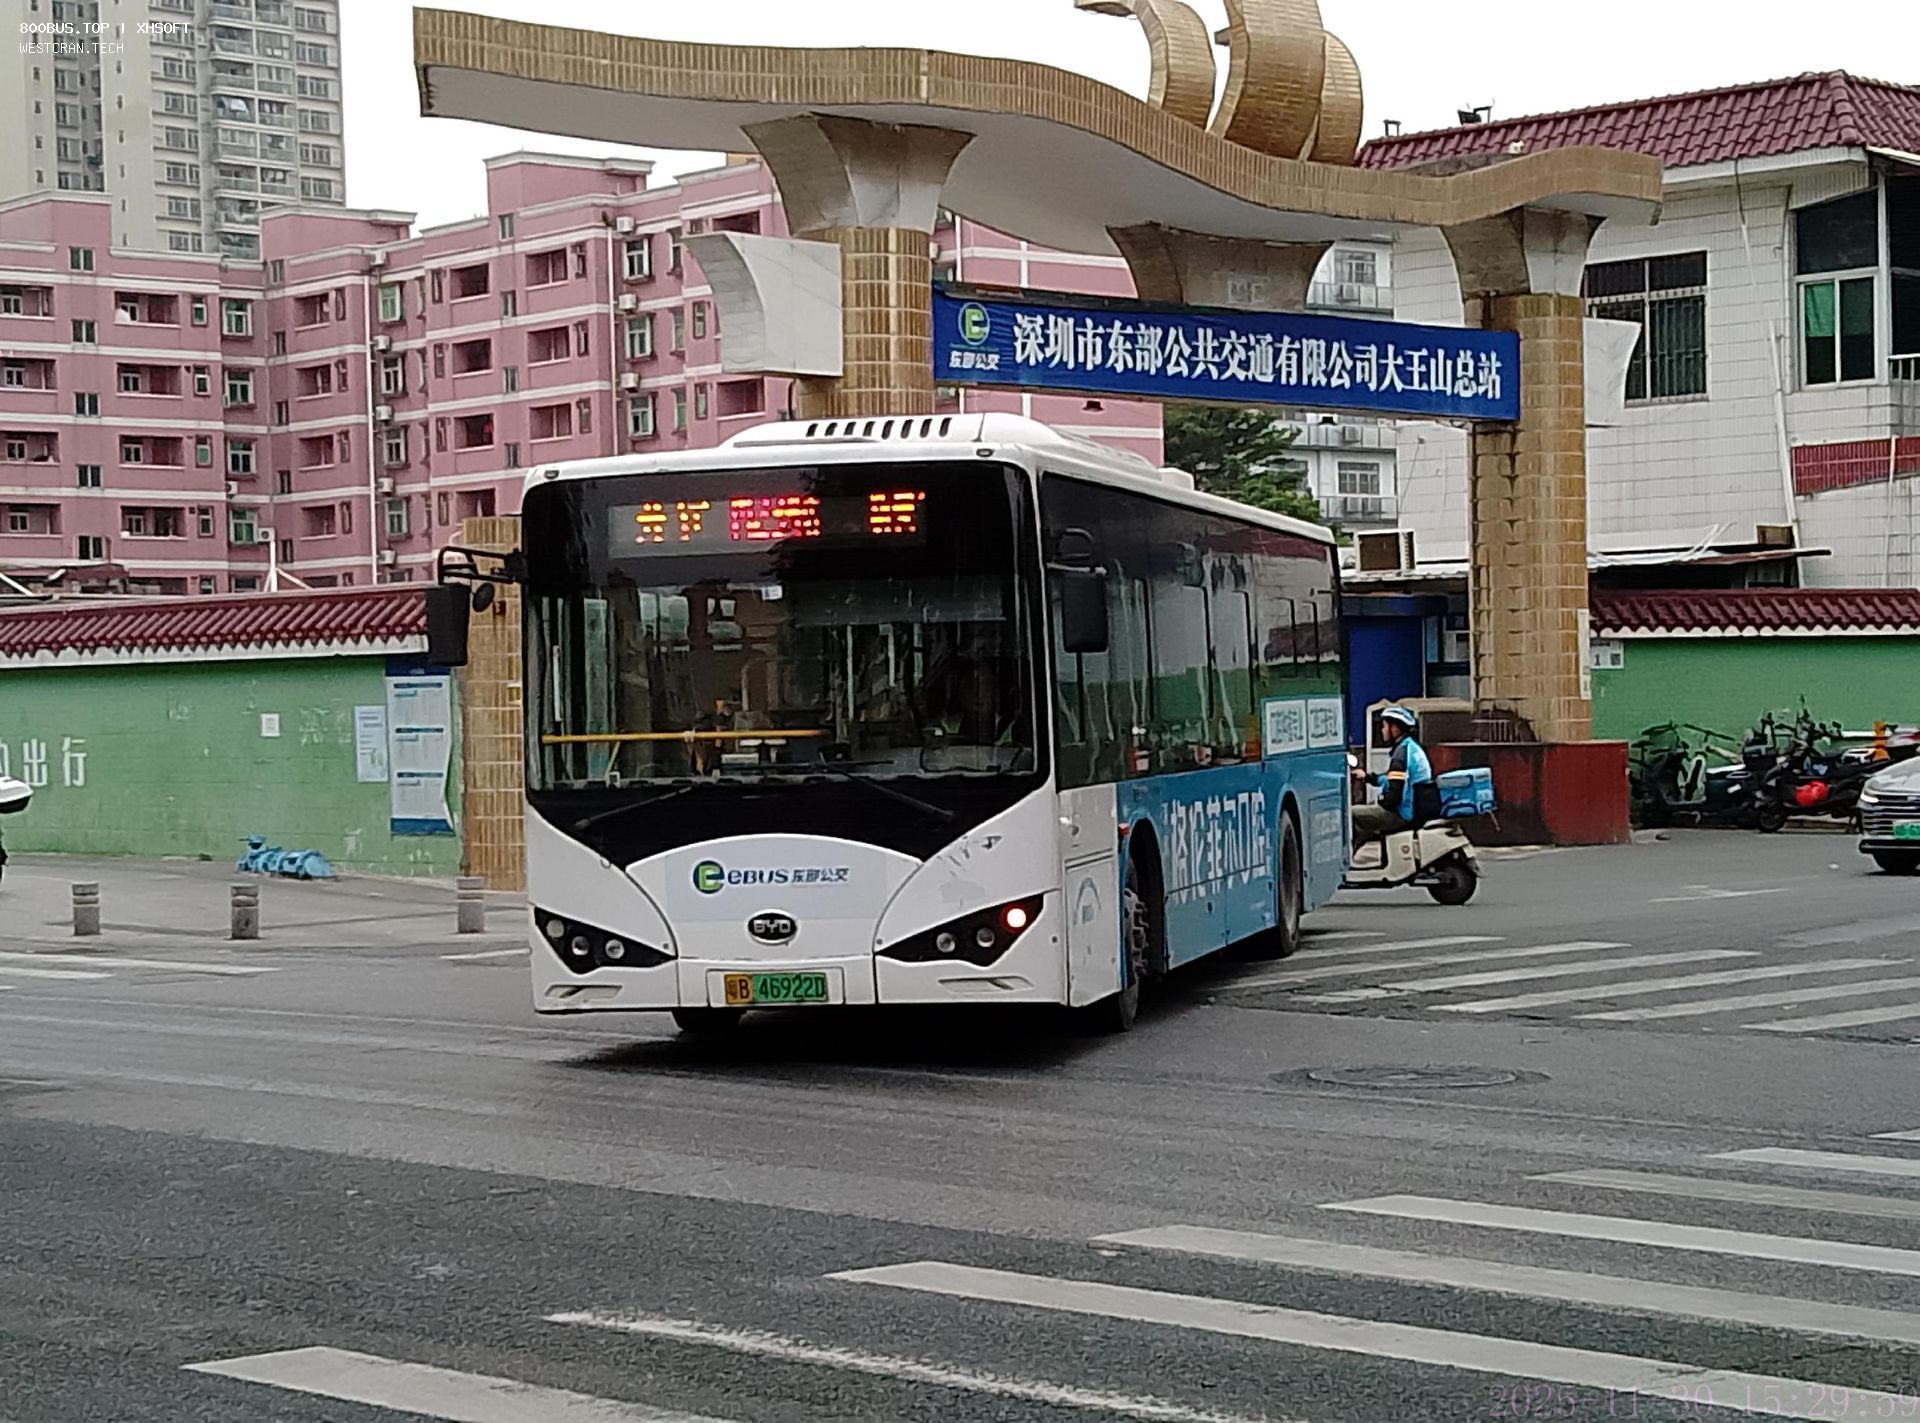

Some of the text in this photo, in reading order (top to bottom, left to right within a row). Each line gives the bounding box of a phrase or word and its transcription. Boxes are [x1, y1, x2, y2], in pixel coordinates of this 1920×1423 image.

[1012, 311, 1503, 400] 深圳市东部公共交通有限公司大王山总站
[753, 919, 791, 933] BYD
[758, 976, 826, 999] 46922D
